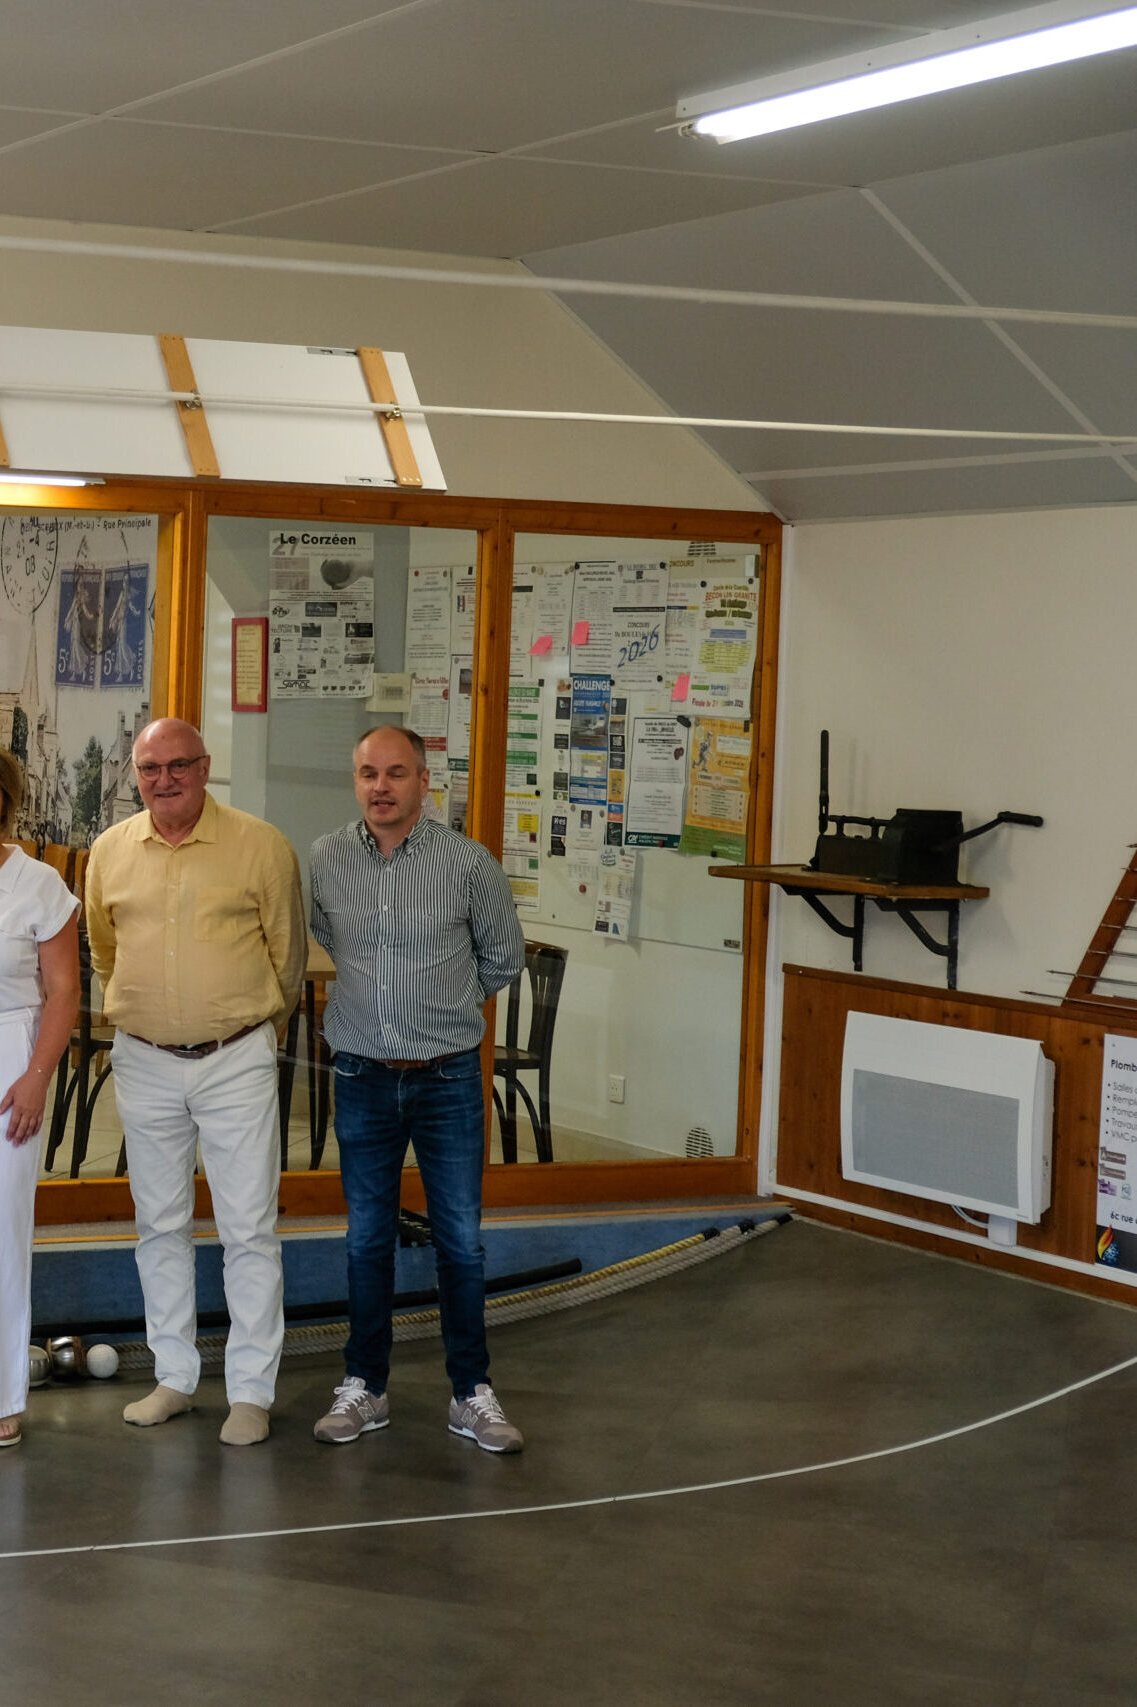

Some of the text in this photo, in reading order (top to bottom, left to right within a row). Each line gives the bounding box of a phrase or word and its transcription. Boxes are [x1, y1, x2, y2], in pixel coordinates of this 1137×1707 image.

[117, 518, 151, 530] Principale
[280, 533, 356, 545] Le Corzéen
[617, 624, 660, 669] 2026
[136, 640, 144, 680] POSTES
[573, 680, 610, 691] CHALLENGE
[1121, 1213, 1134, 1224] rue
